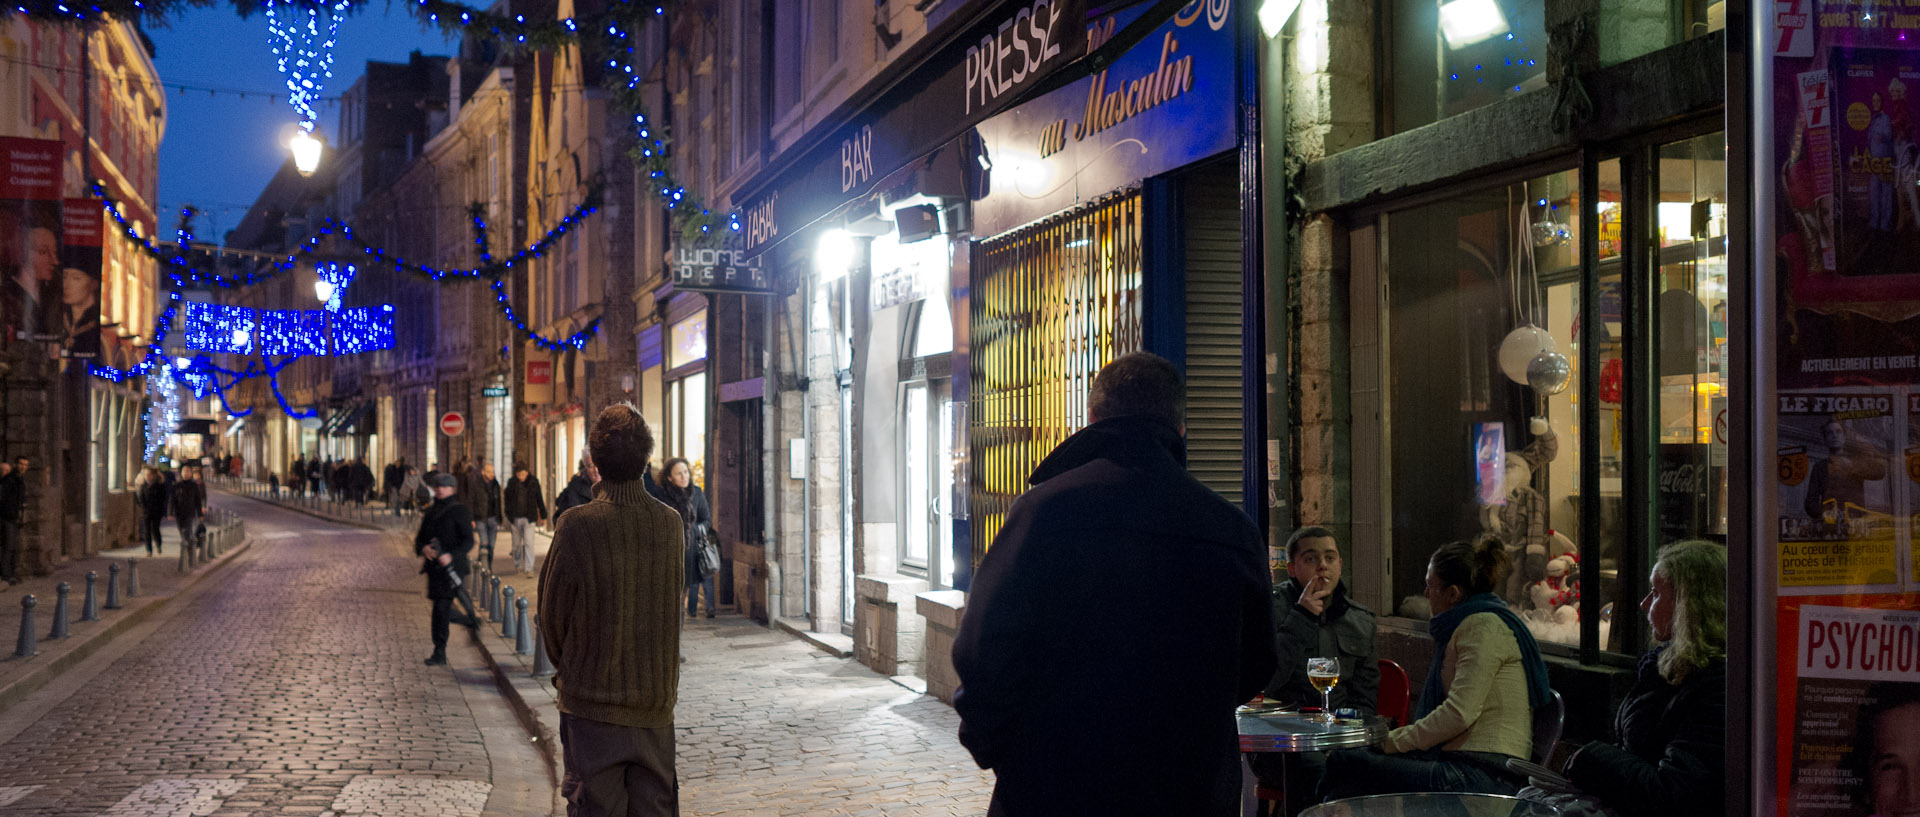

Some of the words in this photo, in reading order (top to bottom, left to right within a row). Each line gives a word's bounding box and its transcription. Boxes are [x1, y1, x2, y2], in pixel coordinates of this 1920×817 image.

[1819, 12, 1850, 28] avec
[965, 0, 1061, 115] PRESSE
[1039, 119, 1067, 158] au
[1073, 31, 1193, 142] Masculin
[842, 124, 874, 193] BAR
[746, 190, 778, 250] TABAC
[1801, 357, 1871, 373] ACTUELLEMENT
[1872, 357, 1887, 370] EN
[1888, 355, 1916, 369] VENTE
[1780, 396, 1809, 413] LE
[1812, 396, 1890, 413] FIGARO
[1782, 545, 1798, 555] Au
[1801, 545, 1830, 555] cœur
[1832, 544, 1851, 555] des
[1854, 544, 1890, 558] grands
[1782, 556, 1819, 568] procès
[1822, 556, 1836, 567] de
